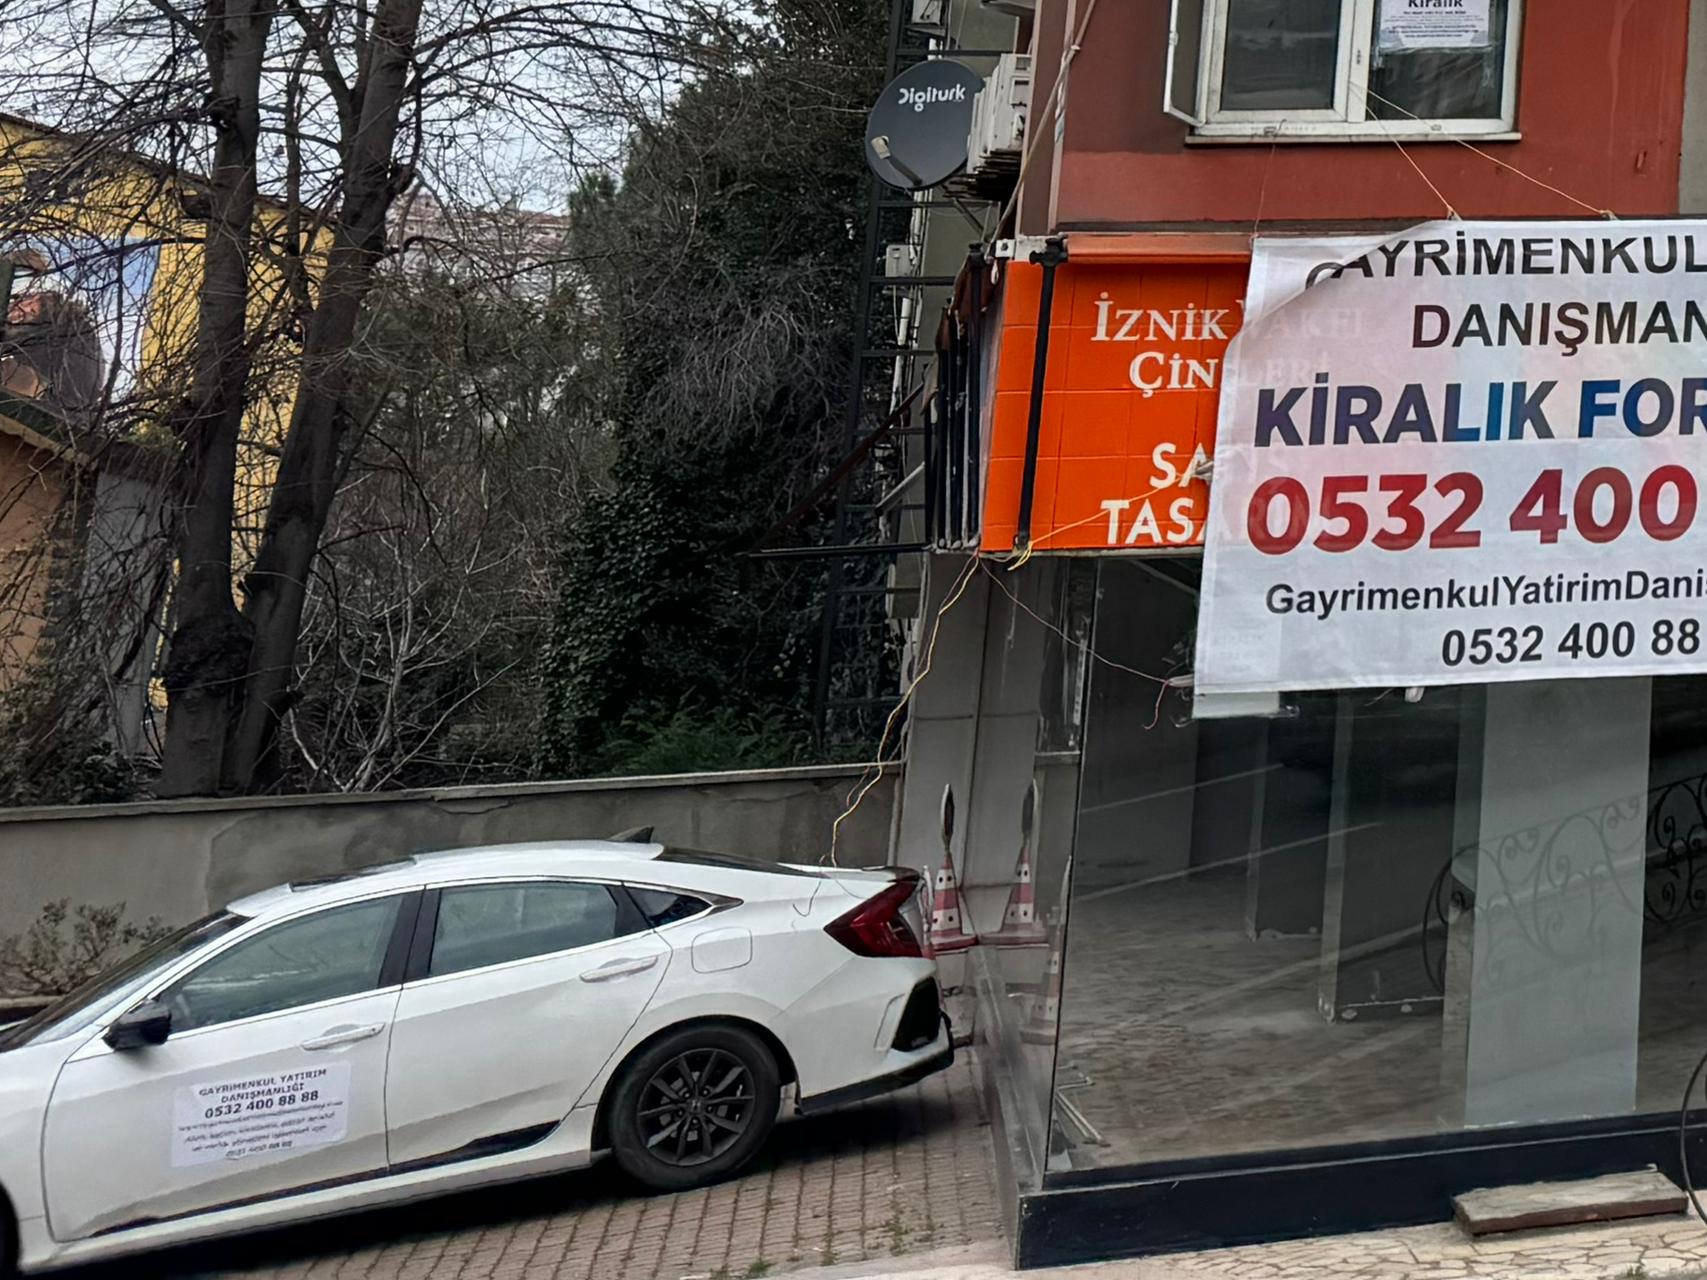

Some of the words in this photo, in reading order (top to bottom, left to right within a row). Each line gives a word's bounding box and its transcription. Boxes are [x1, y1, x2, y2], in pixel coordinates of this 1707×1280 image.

[1090, 291, 1230, 342] İZNİK
[1253, 371, 1559, 448] KİRALIK
[1246, 470, 1484, 556] 0532
[1509, 462, 1699, 546] 400
[1440, 624, 1545, 668] 0532
[1556, 620, 1634, 662] 400
[1650, 618, 1700, 659] 88
[280, 1068, 328, 1084] YATIRIM
[204, 1102, 242, 1120] 0532
[245, 1096, 275, 1112] 400
[278, 1092, 297, 1107] 88
[300, 1089, 320, 1103] 88
